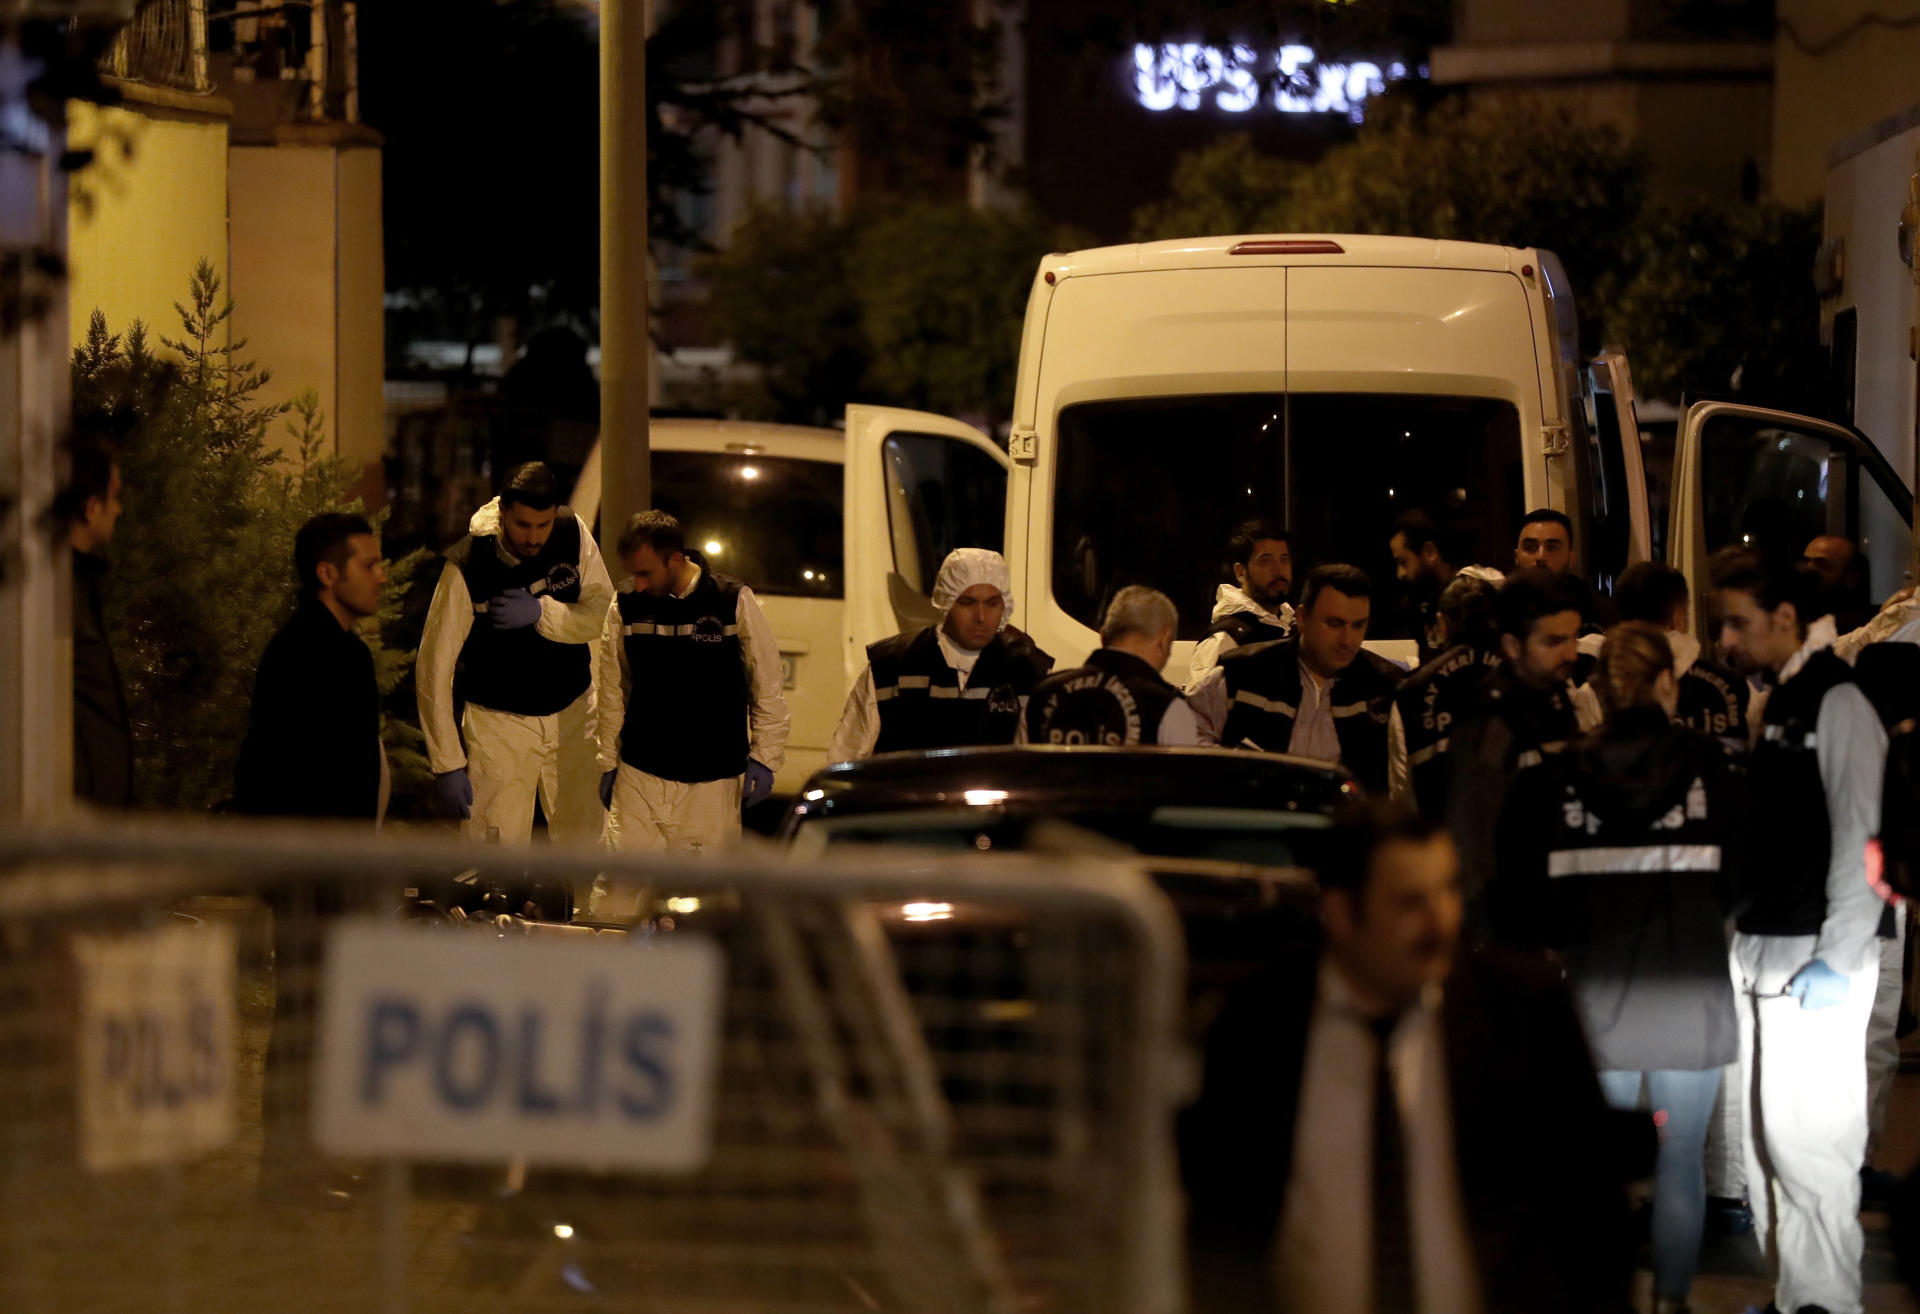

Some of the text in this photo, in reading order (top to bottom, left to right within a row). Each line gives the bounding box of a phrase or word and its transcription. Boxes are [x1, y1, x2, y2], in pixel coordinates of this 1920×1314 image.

[1134, 43, 1402, 124] UPS Exp
[362, 974, 678, 1122] POLİS
